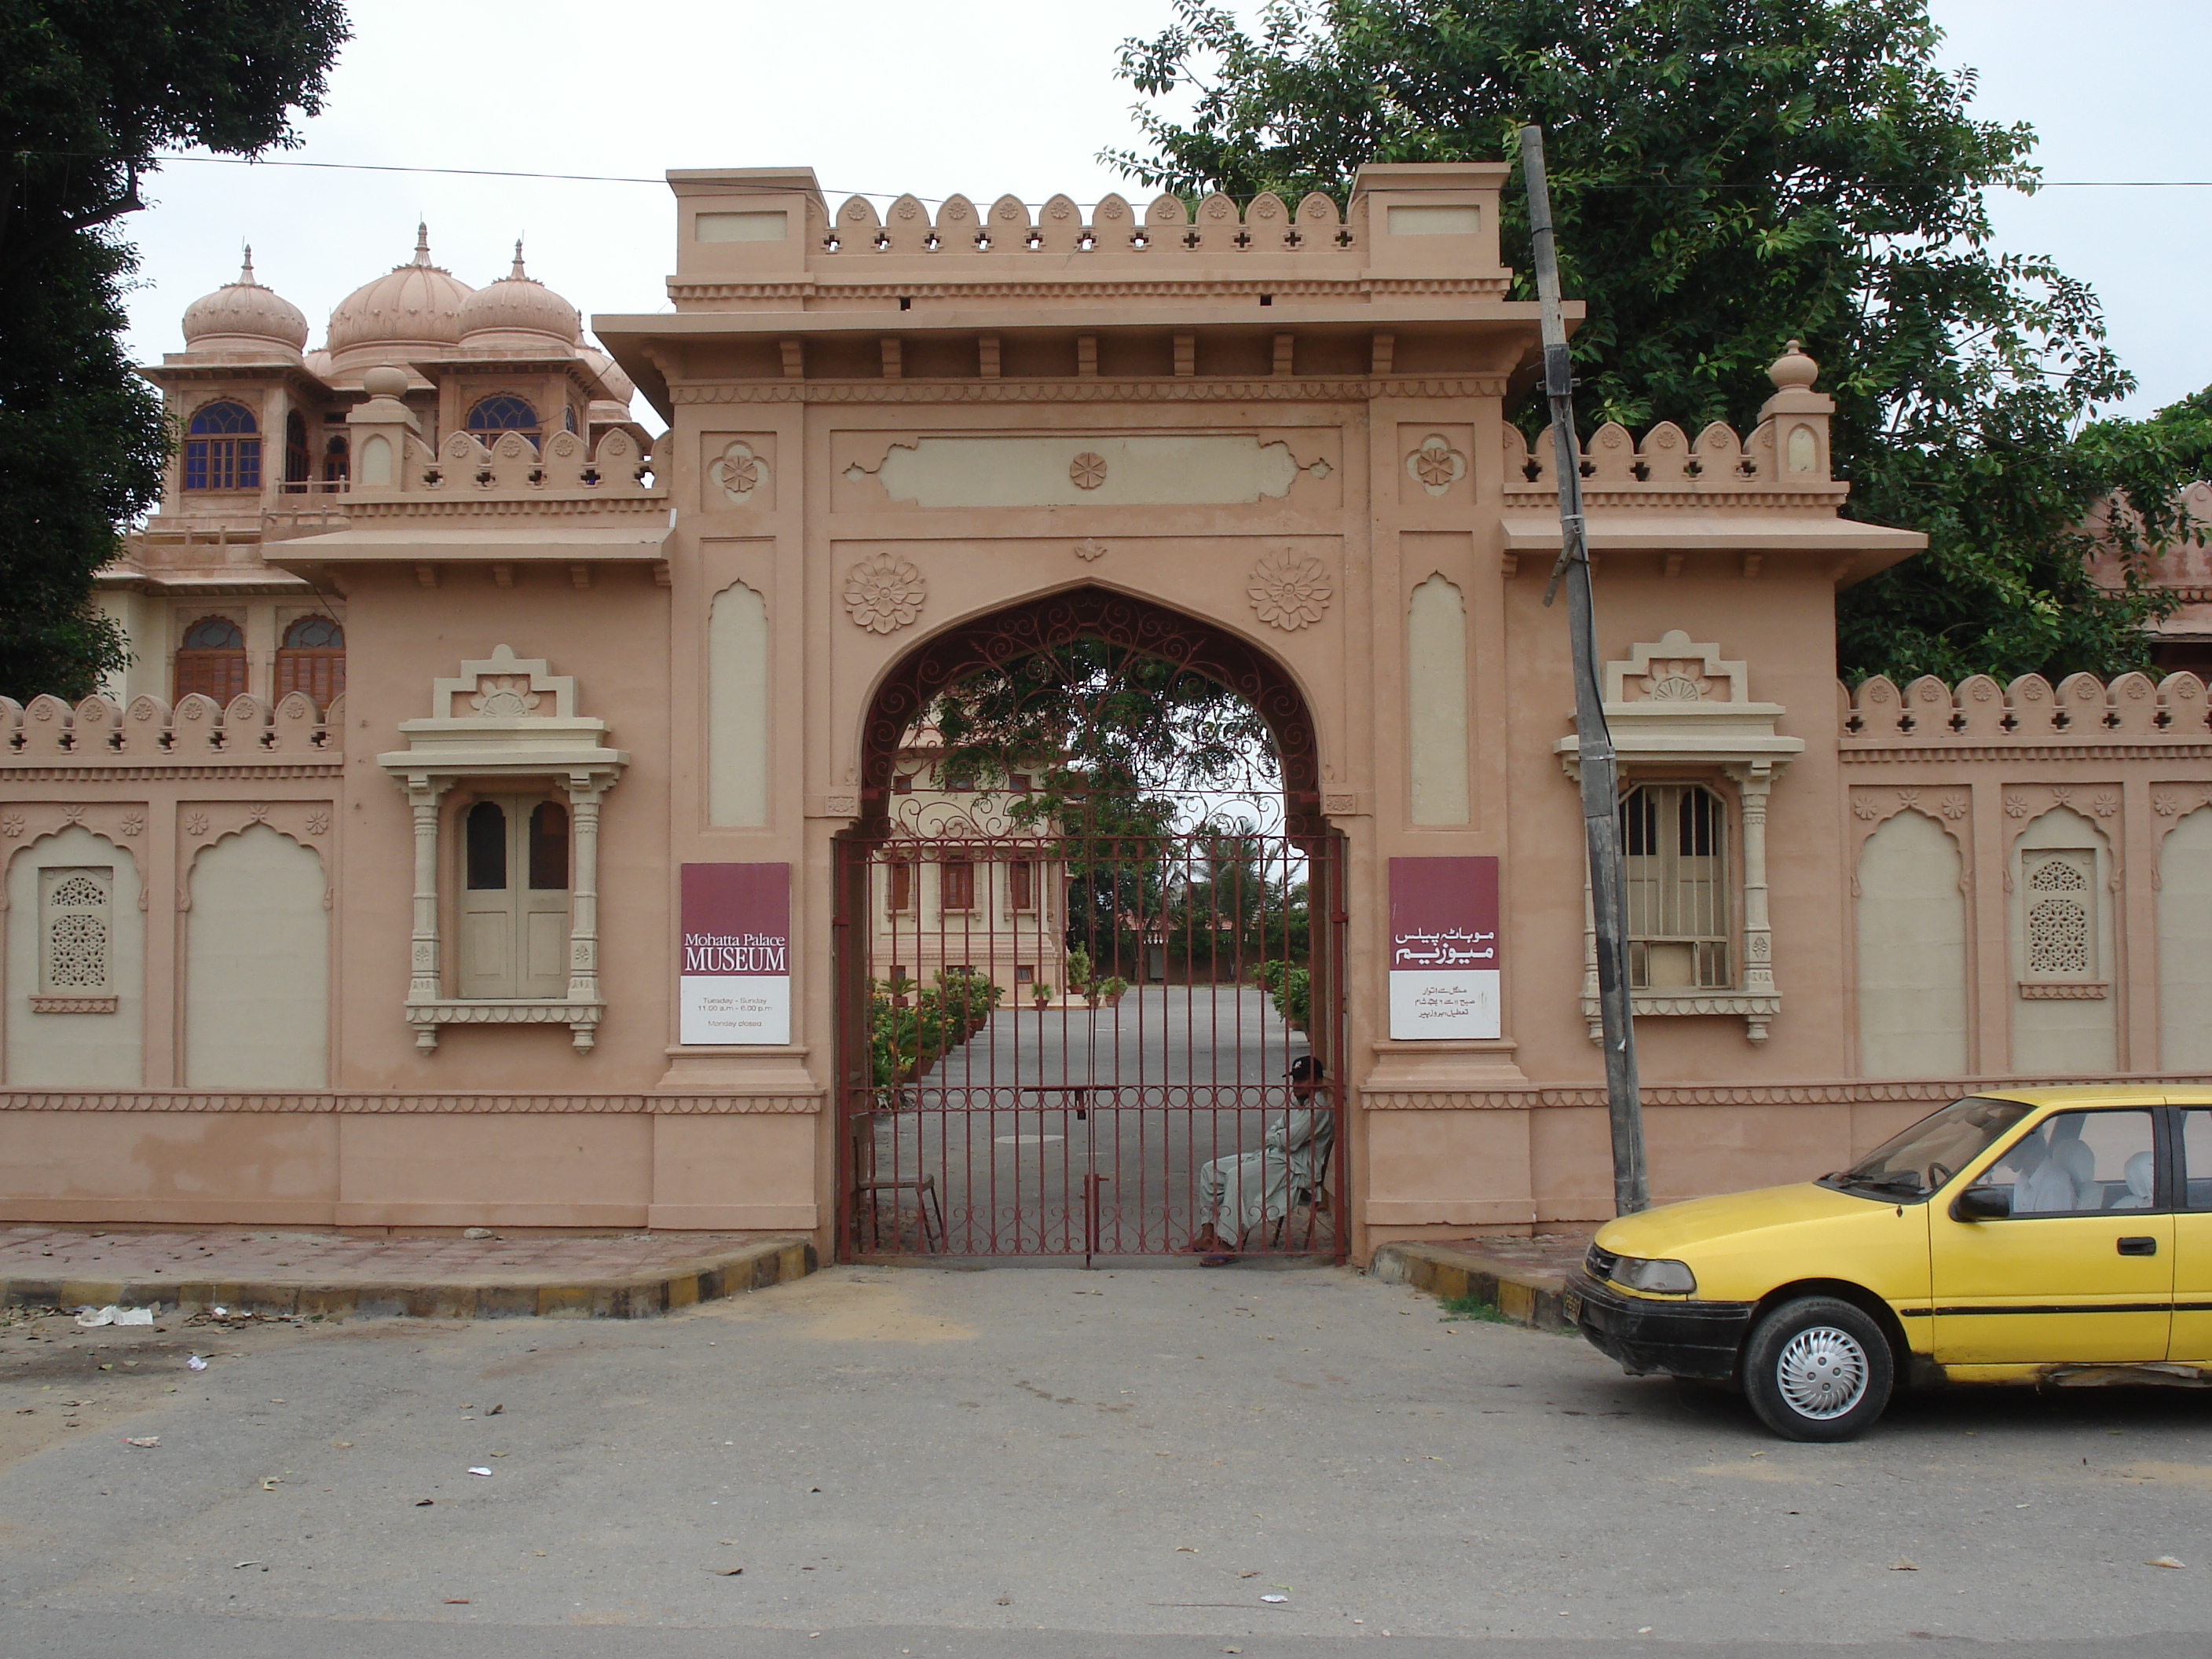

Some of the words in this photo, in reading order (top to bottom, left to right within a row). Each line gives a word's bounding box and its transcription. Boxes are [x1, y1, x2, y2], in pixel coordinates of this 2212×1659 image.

[684, 932, 740, 947] Mohatta
[743, 932, 786, 947] Palace
[1395, 927, 1440, 947] پیلس
[684, 947, 786, 972] MUSEUM
[1396, 943, 1494, 965] میوزیم
[1422, 987, 1437, 996] اتوار
[1450, 986, 1467, 995] منگل
[1415, 998, 1427, 1006] شام
